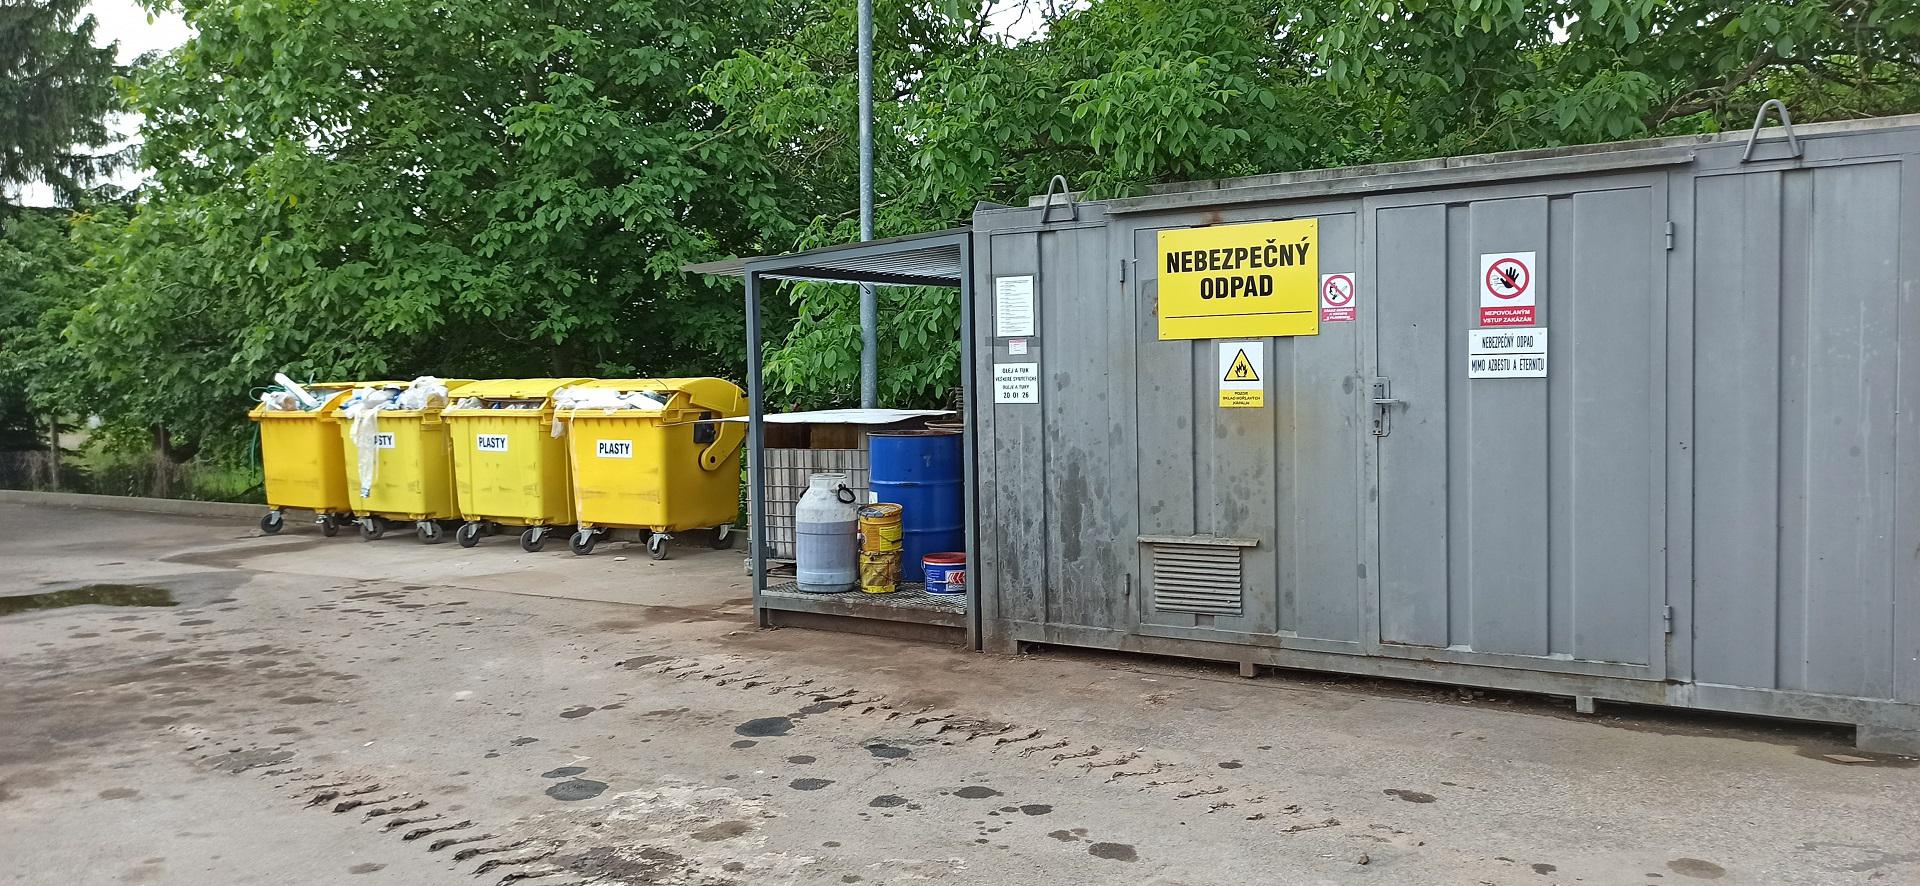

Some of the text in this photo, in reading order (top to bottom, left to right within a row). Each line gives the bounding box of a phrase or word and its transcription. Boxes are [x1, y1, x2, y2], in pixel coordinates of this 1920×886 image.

[1166, 236, 1310, 274] NEBEZPEČNÝ
[1200, 274, 1273, 300] ODPAD
[1482, 333, 1534, 349] NEBEZPEČNÝ ODPAD
[1488, 358, 1511, 371] AZBESTU
[1513, 358, 1517, 370] A
[1003, 391, 1030, 399] 20 01 26
[374, 435, 393, 446] ASTY
[478, 436, 506, 450] PLASTY
[598, 442, 630, 456] PLASTY
